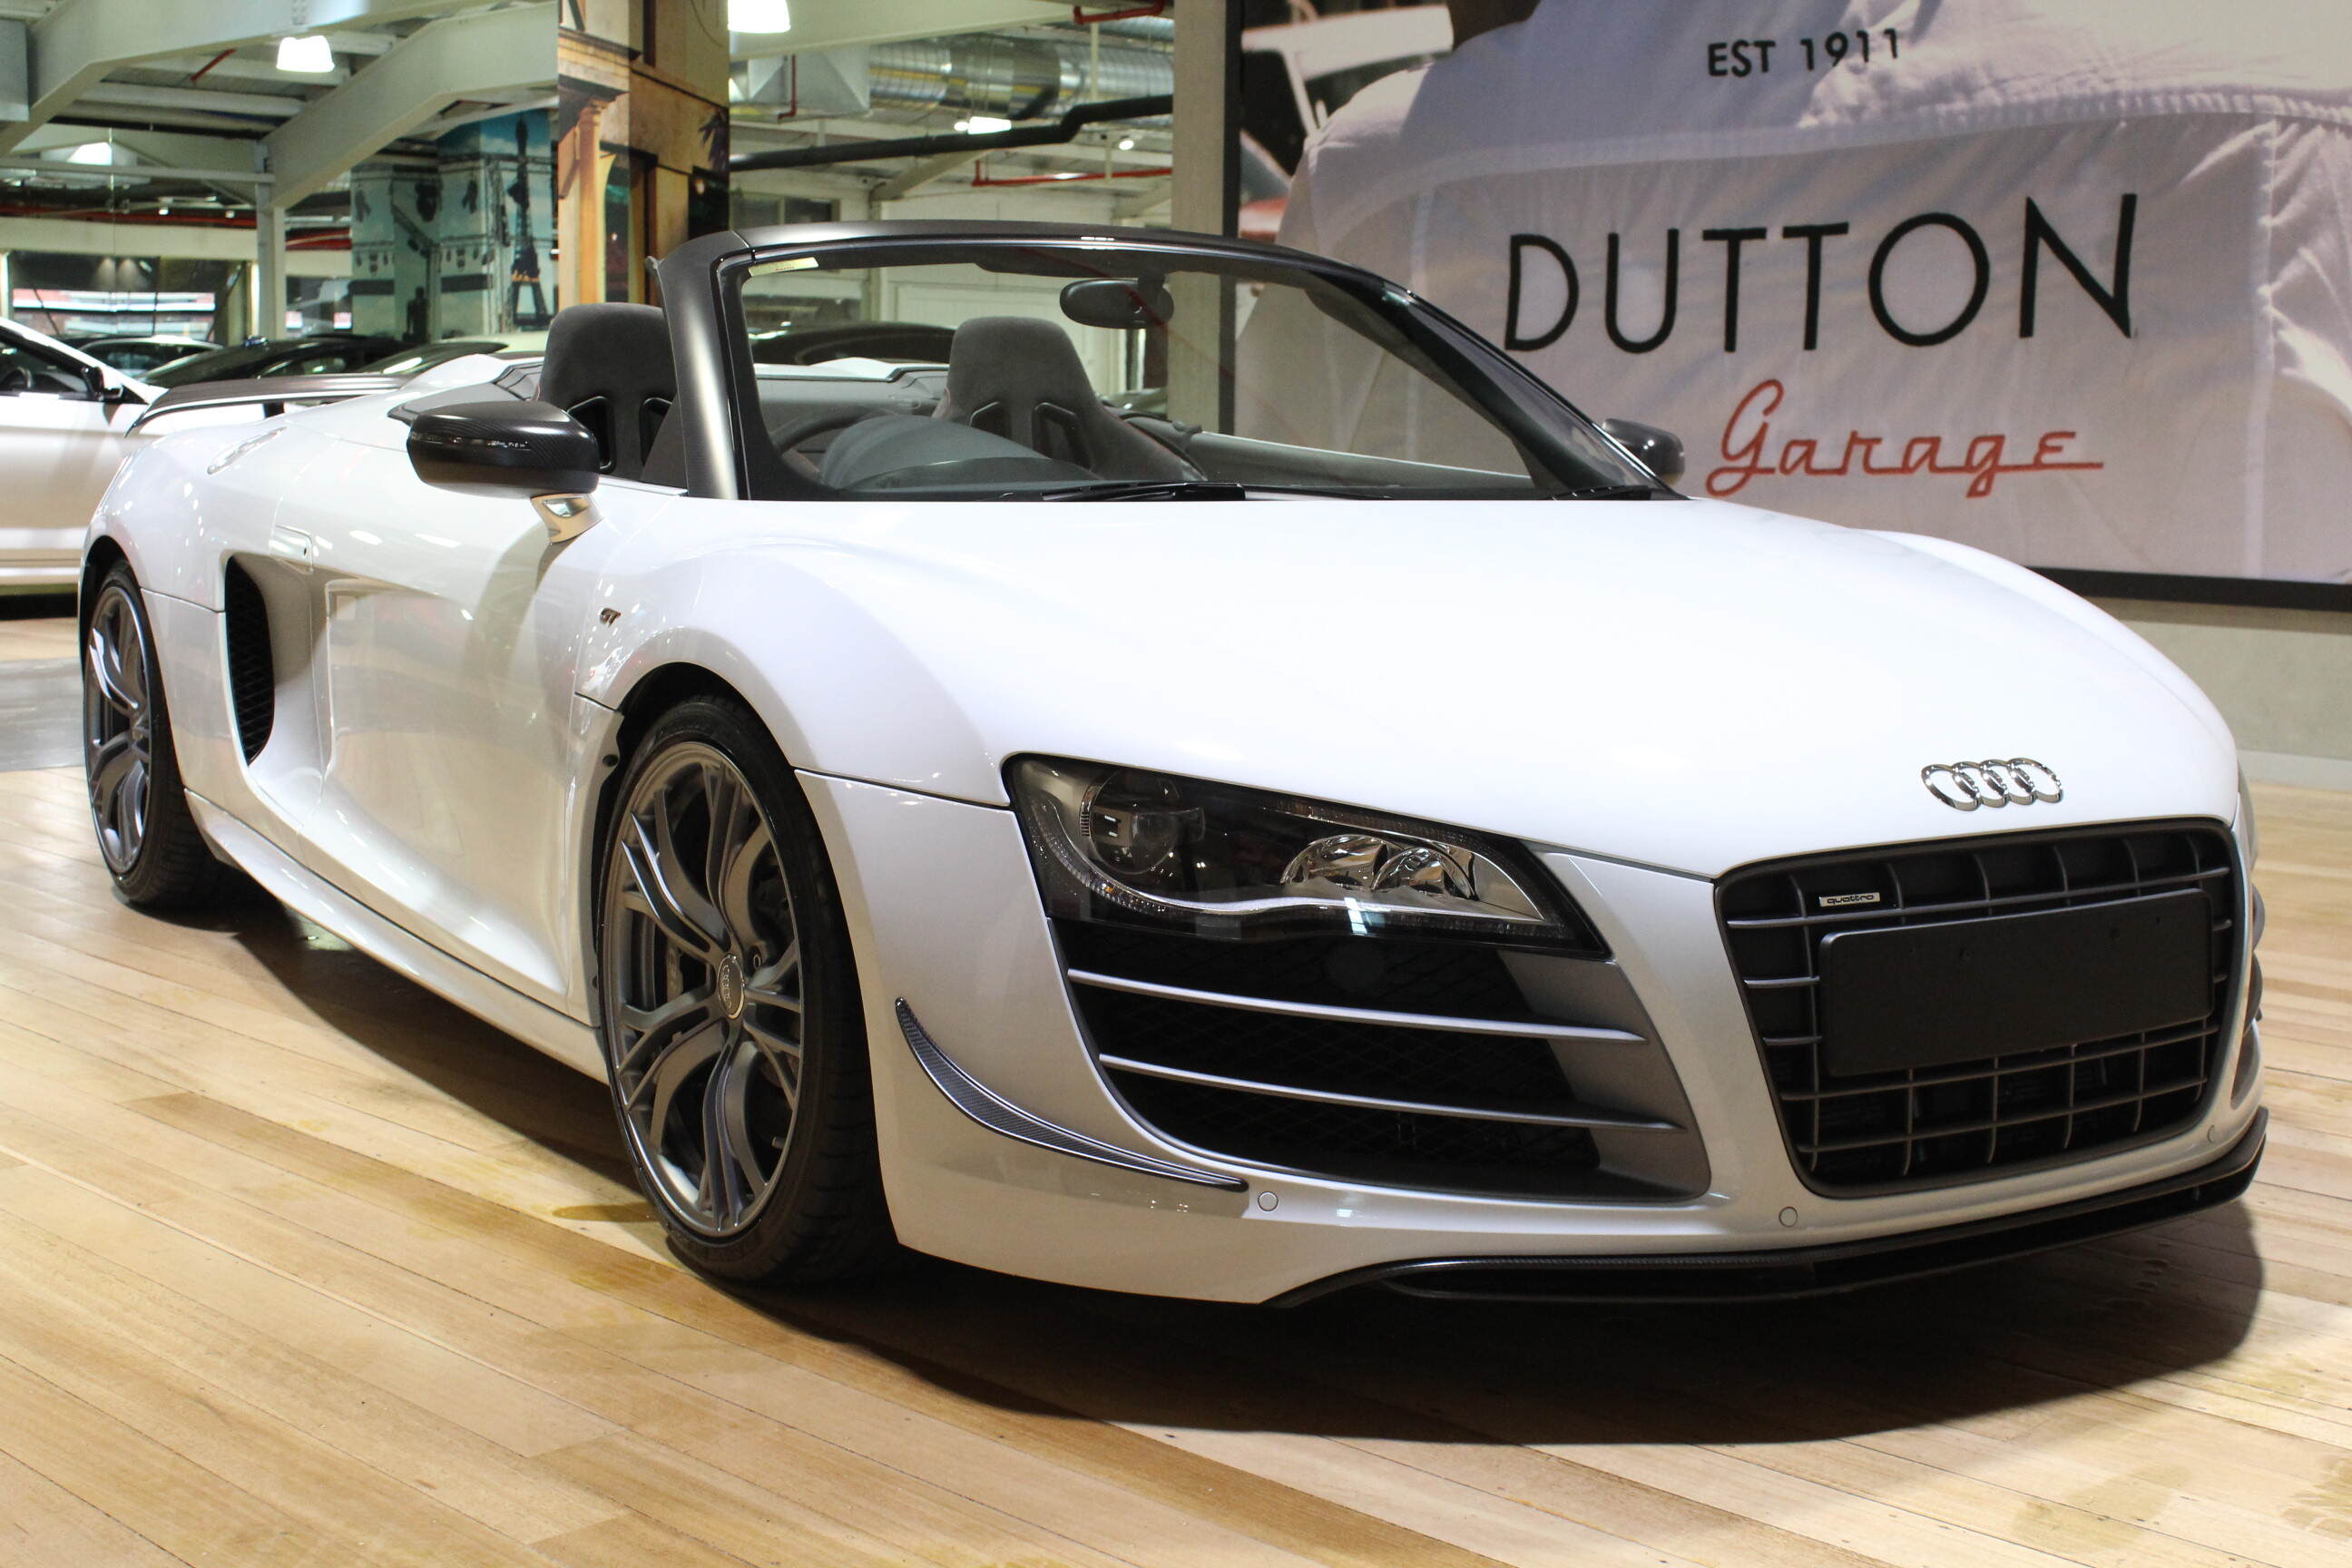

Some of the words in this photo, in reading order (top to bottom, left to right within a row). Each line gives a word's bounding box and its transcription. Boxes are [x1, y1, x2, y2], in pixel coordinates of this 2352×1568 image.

[1708, 39, 1776, 77] EST
[1800, 28, 1898, 72] 1911
[1504, 192, 2138, 354] DUTTON
[1705, 379, 2104, 498] Garage
[1827, 894, 1875, 905] quattro
